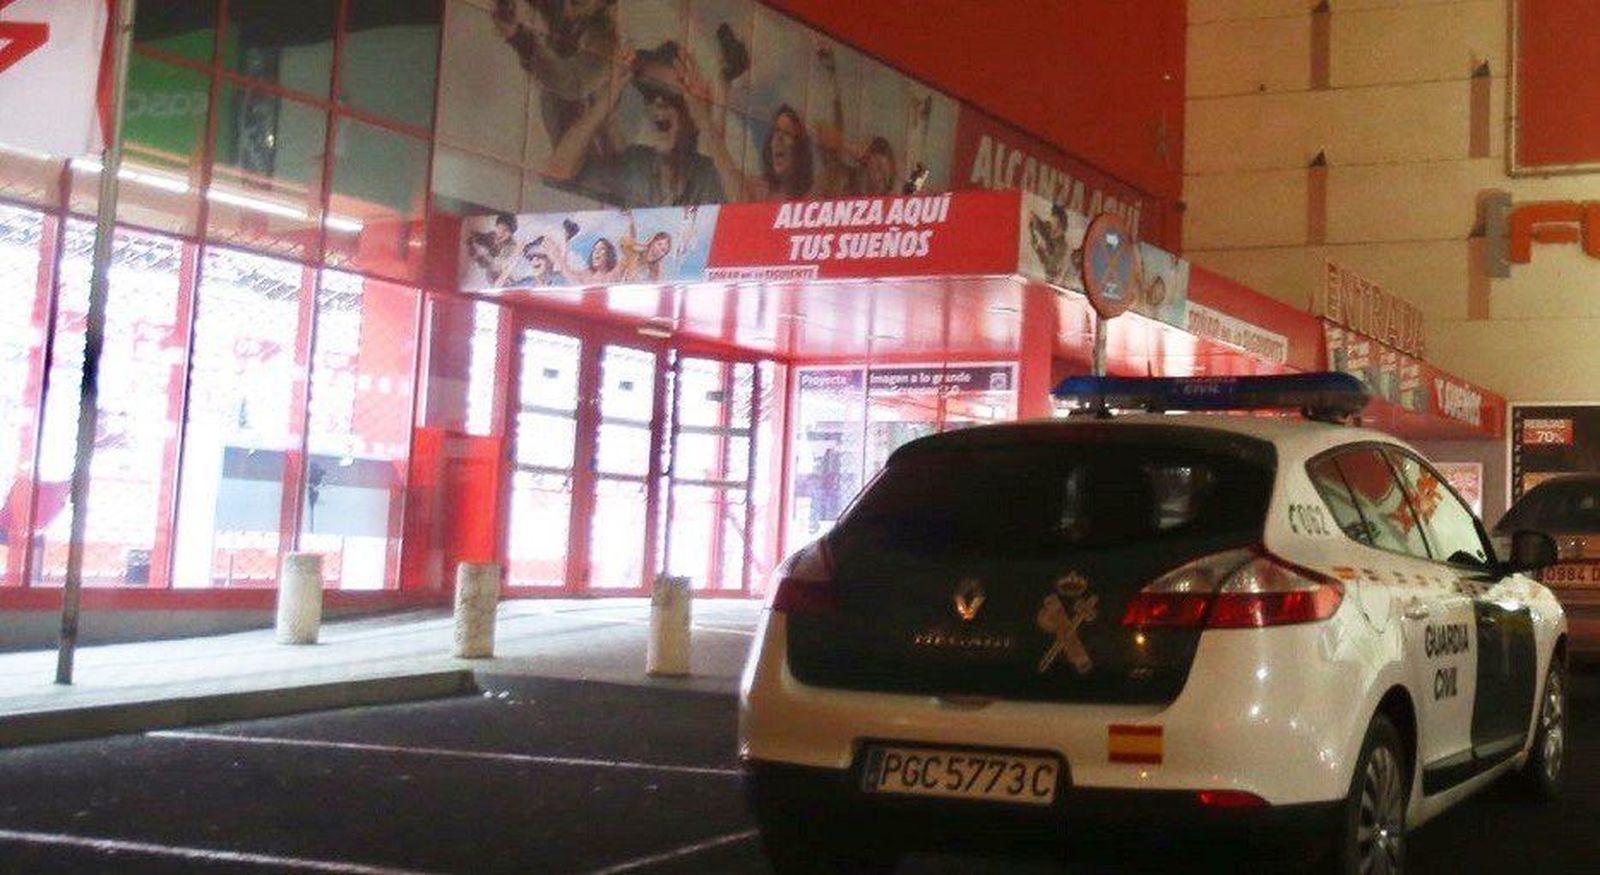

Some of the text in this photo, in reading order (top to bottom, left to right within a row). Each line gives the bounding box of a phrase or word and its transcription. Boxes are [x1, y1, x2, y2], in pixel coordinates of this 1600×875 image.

[773, 193, 951, 229] ALCANZA AQUÍ
[789, 227, 934, 262] TUS SUEÑOS
[1324, 258, 1425, 361] ENTRADA
[870, 373, 908, 387] Imagen
[1425, 624, 1469, 659] GUARDIA
[1434, 667, 1457, 701] CIVIL
[880, 753, 1052, 797] PGC5773C
